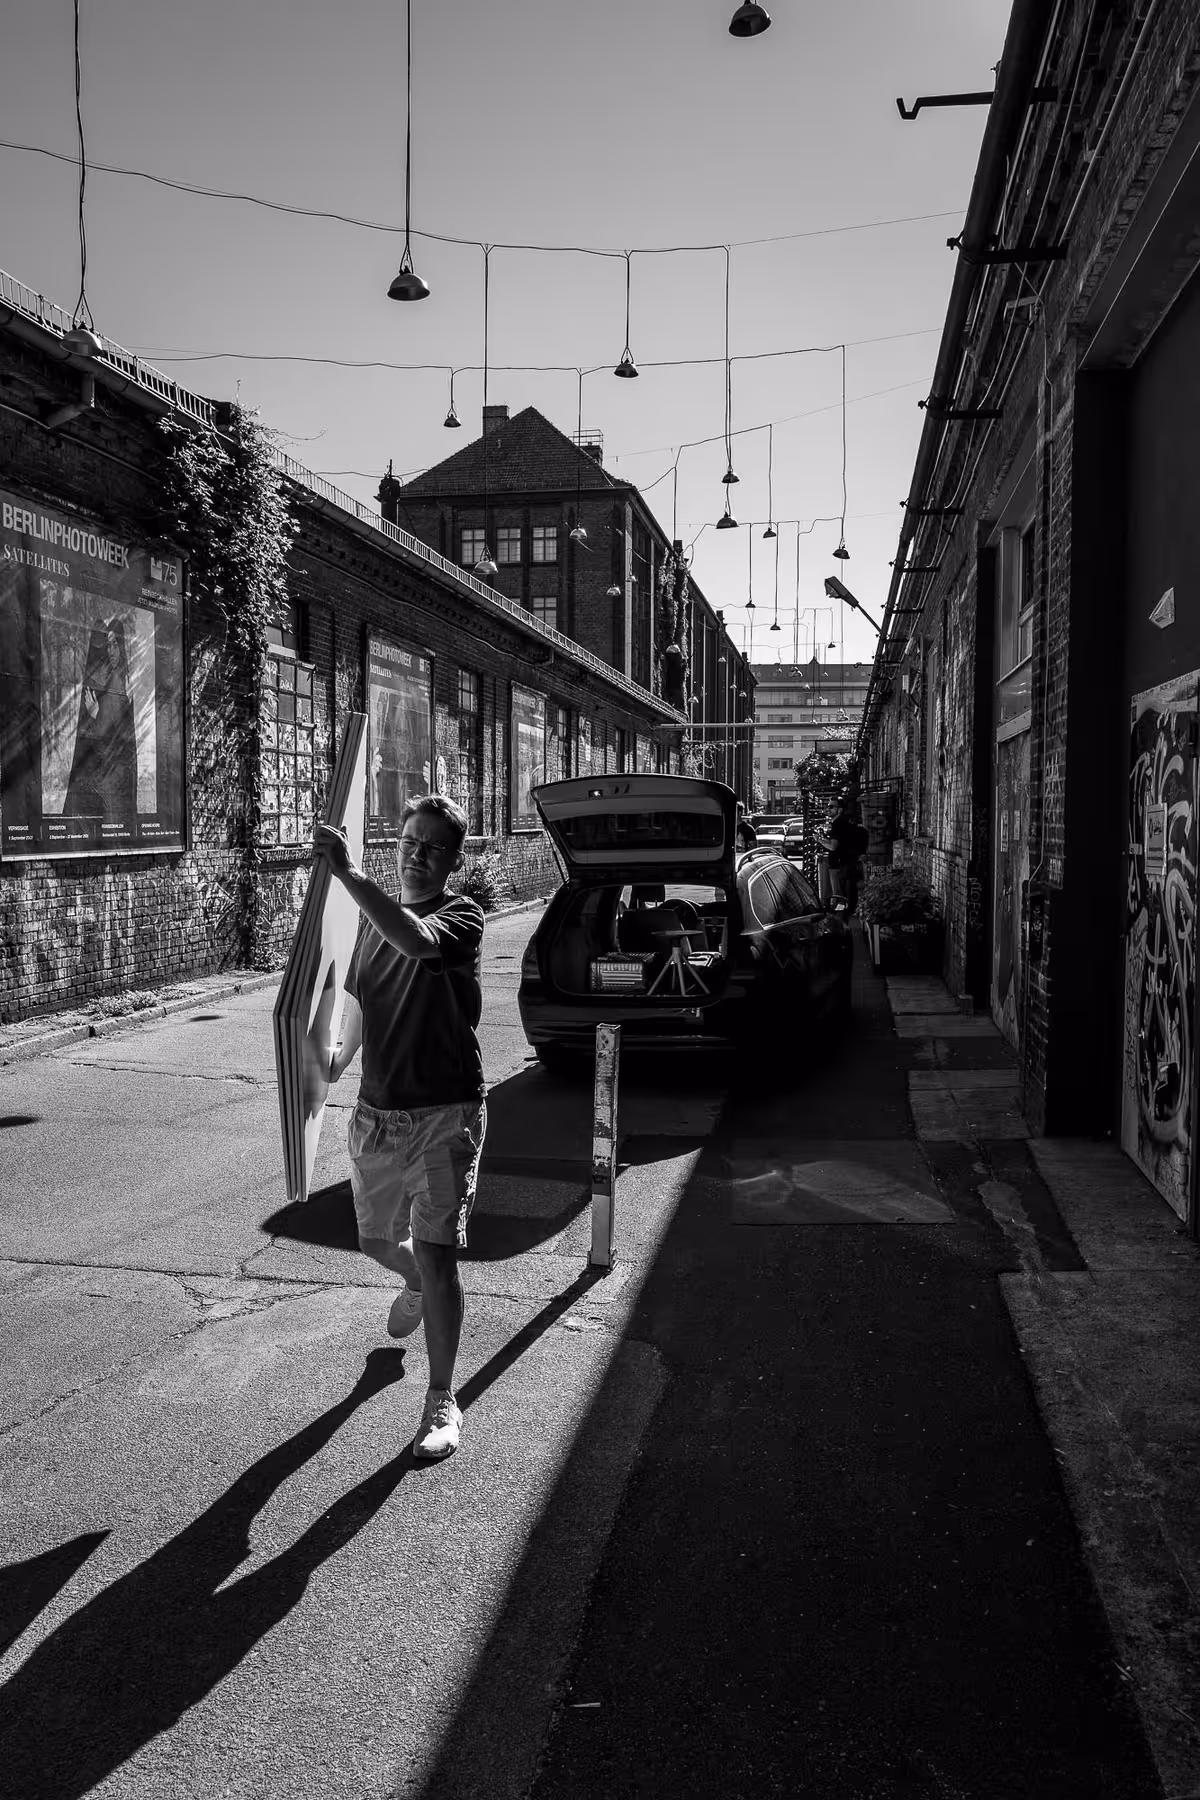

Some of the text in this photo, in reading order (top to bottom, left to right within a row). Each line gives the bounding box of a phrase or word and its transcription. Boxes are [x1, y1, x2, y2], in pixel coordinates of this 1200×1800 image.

[2, 502, 130, 569] BERLINPHOTOWEEK
[3, 543, 70, 577] SATELLITES
[162, 561, 178, 586] 75
[369, 640, 412, 668] BERLINPHOTOWEEK
